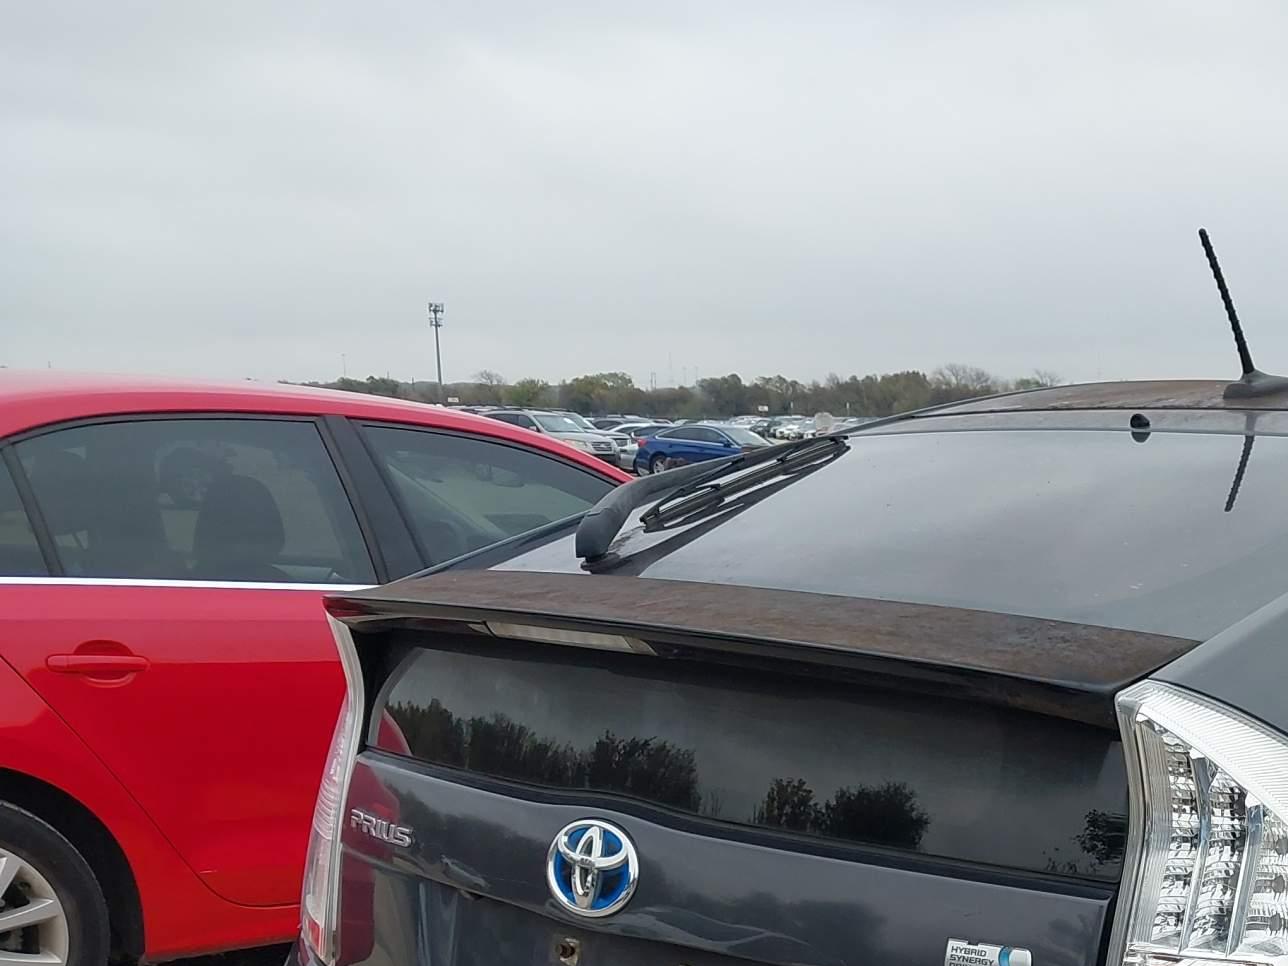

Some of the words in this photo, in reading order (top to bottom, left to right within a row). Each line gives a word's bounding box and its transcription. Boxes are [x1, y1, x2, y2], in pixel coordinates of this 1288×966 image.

[350, 808, 413, 848] PRIUS
[951, 946, 986, 957] HYBRID
[949, 954, 994, 966] SYNERGY
